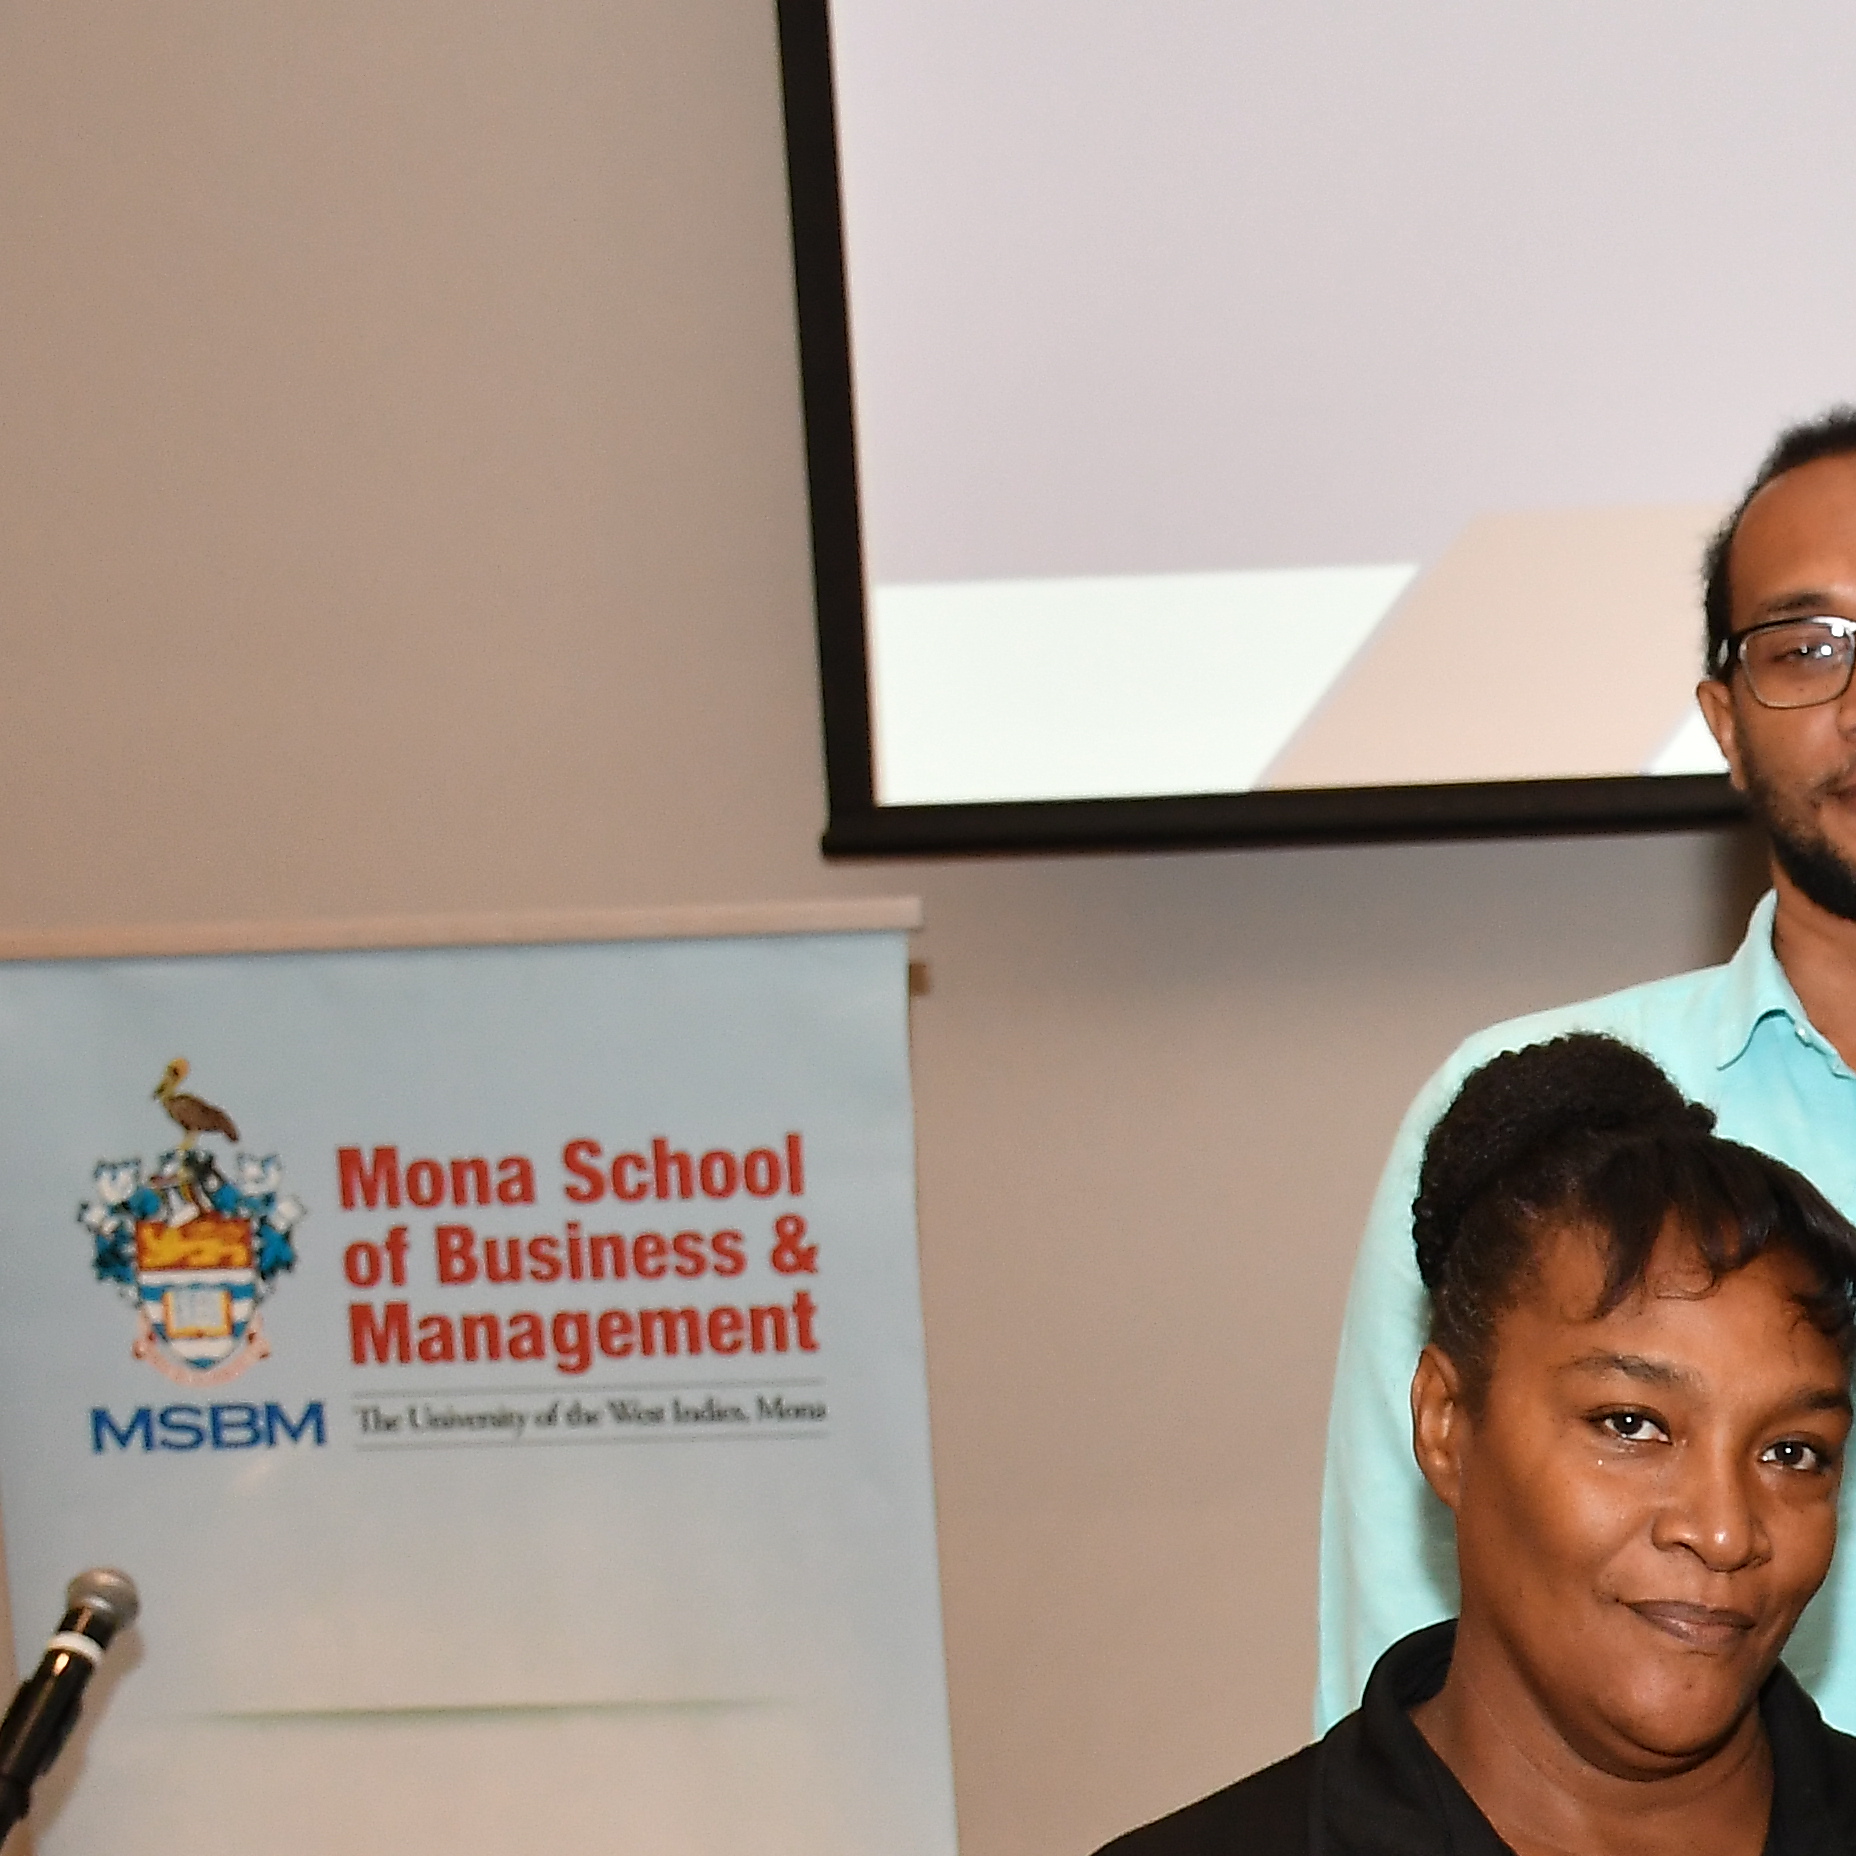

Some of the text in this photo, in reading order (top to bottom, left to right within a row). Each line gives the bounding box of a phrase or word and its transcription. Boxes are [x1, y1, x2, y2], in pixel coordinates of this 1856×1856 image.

[336, 1133, 805, 1212] Mona School
[344, 1213, 820, 1288] of Business &
[349, 1290, 820, 1374] Management
[90, 1402, 328, 1456] MSBM
[357, 1406, 399, 1433] The
[406, 1402, 527, 1438] University
[534, 1398, 561, 1427] of
[566, 1399, 602, 1429] the
[606, 1398, 667, 1426] West
[754, 1393, 829, 1423] Mona
